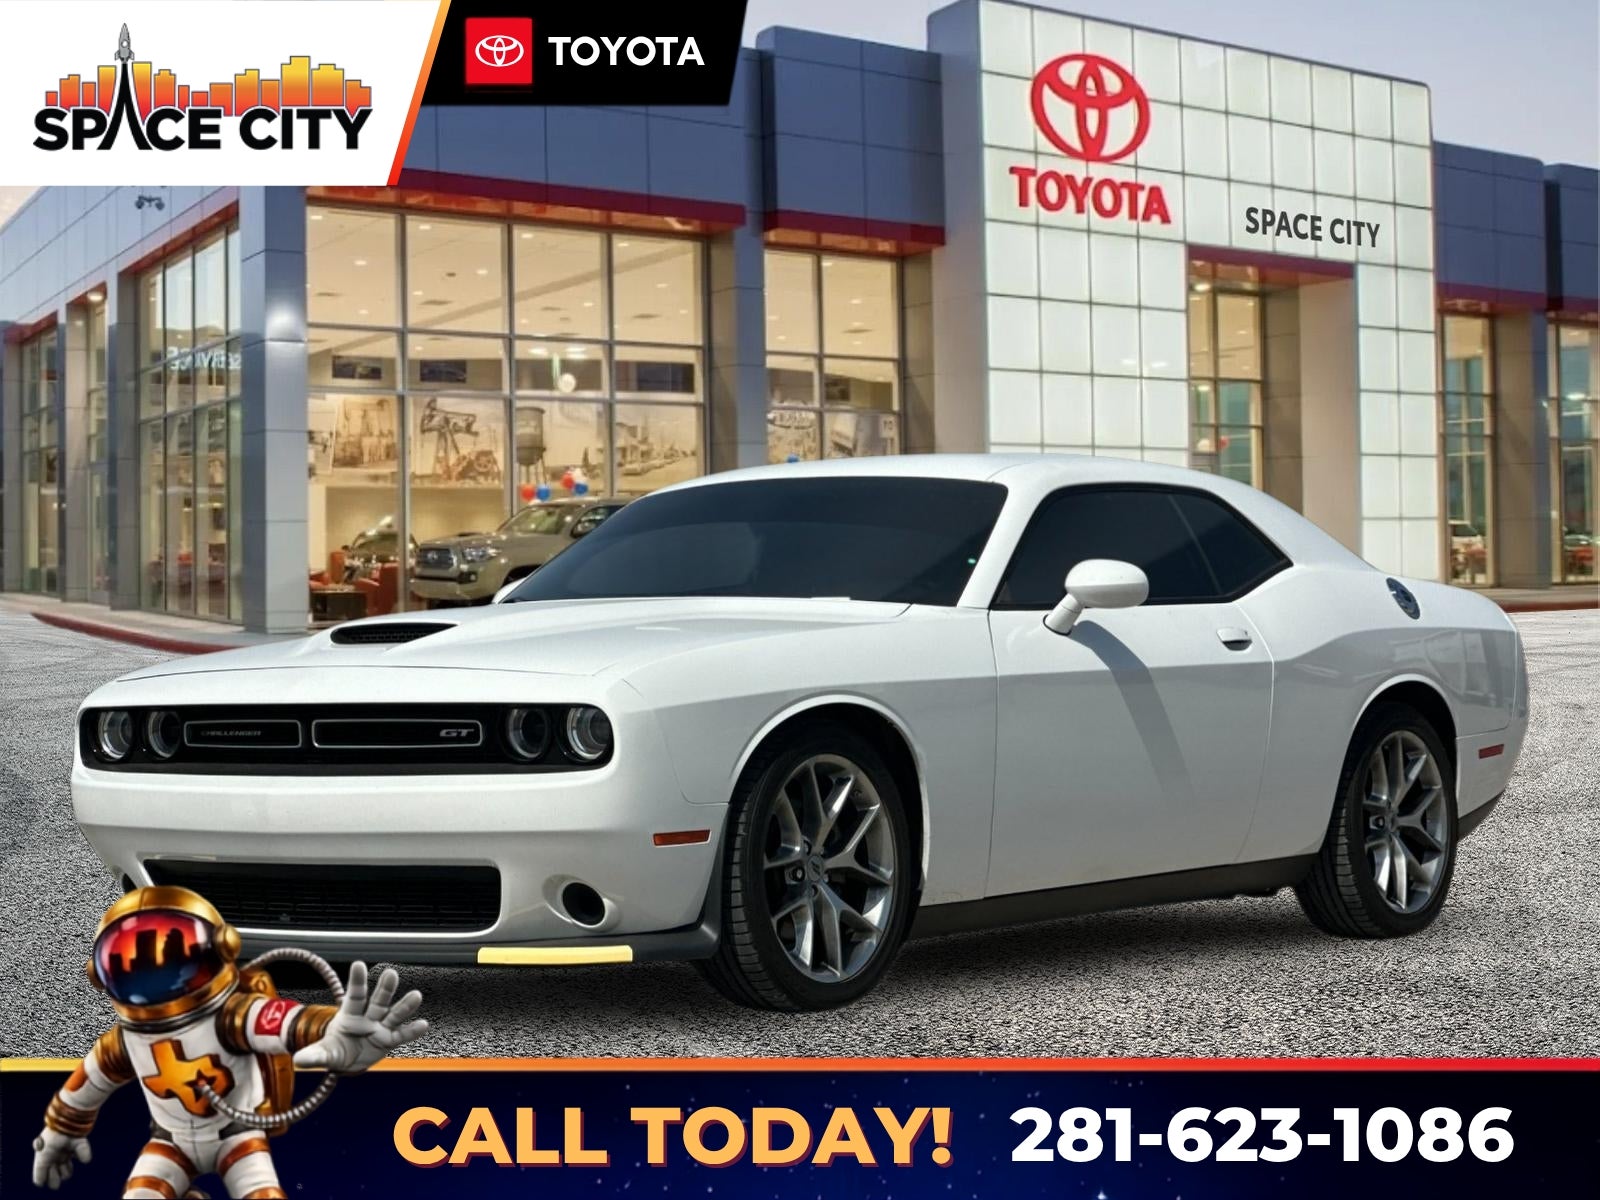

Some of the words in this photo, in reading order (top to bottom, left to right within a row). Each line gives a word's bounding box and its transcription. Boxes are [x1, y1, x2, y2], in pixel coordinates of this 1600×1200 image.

[1009, 166, 1171, 225] TOYOTA
[1245, 206, 1323, 242] SPACE
[1329, 218, 1381, 248] CITY
[440, 728, 475, 737] GT
